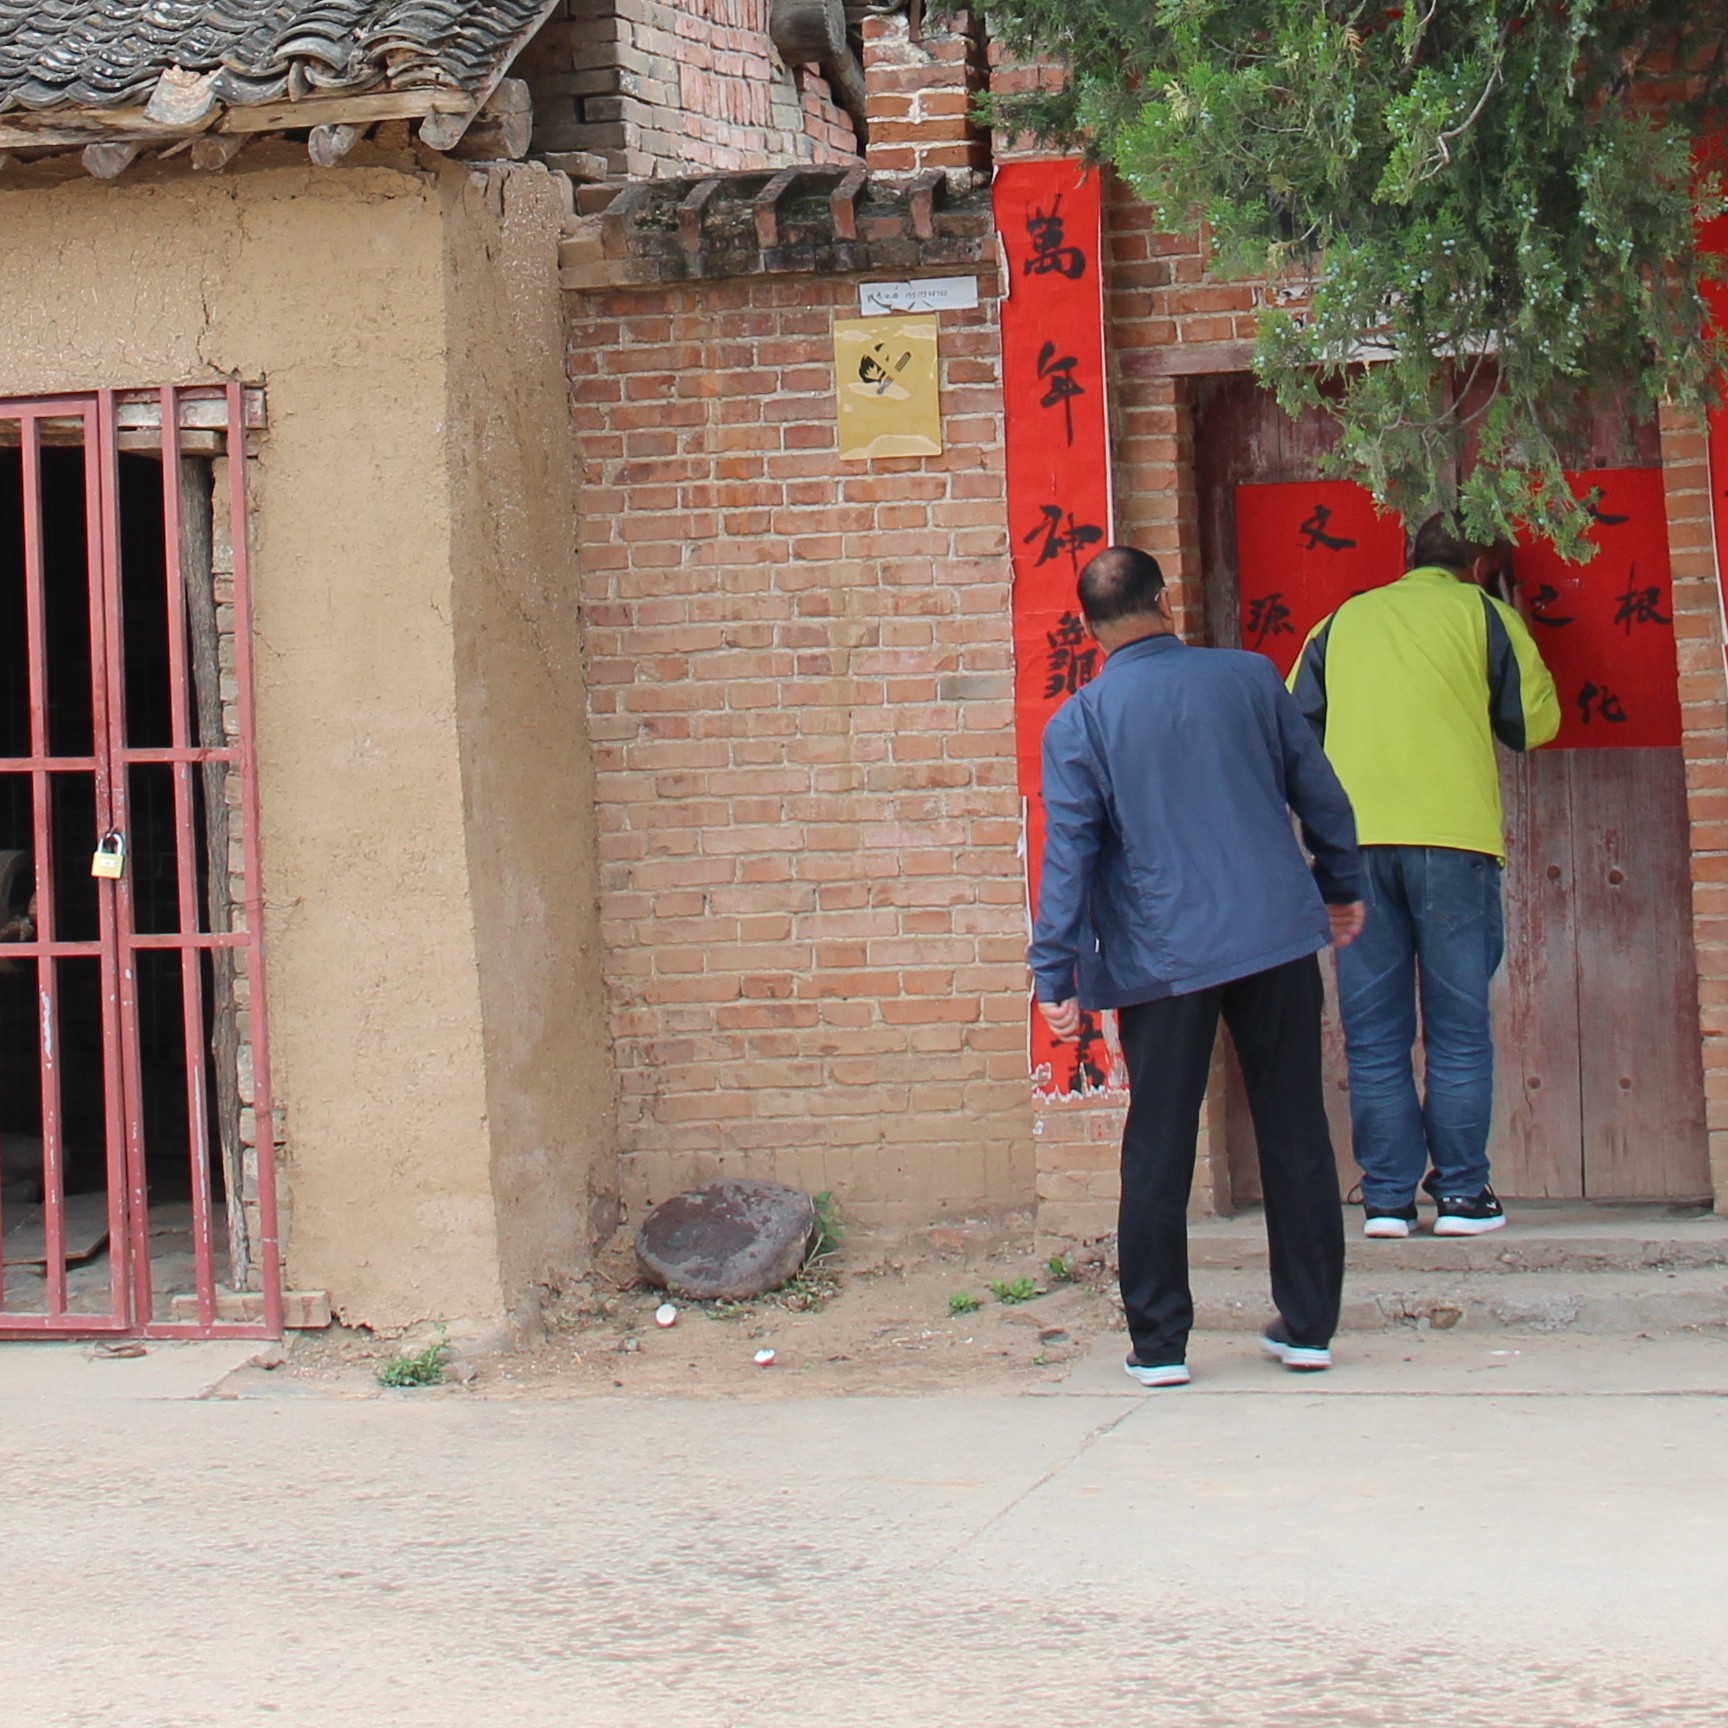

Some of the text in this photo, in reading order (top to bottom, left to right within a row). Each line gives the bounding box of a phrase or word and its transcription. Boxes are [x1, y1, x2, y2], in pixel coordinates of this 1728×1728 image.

[1298, 503, 1357, 550] 文
[1529, 584, 1575, 627] 之
[1613, 560, 1672, 636] 根
[1576, 679, 1627, 725] 化
